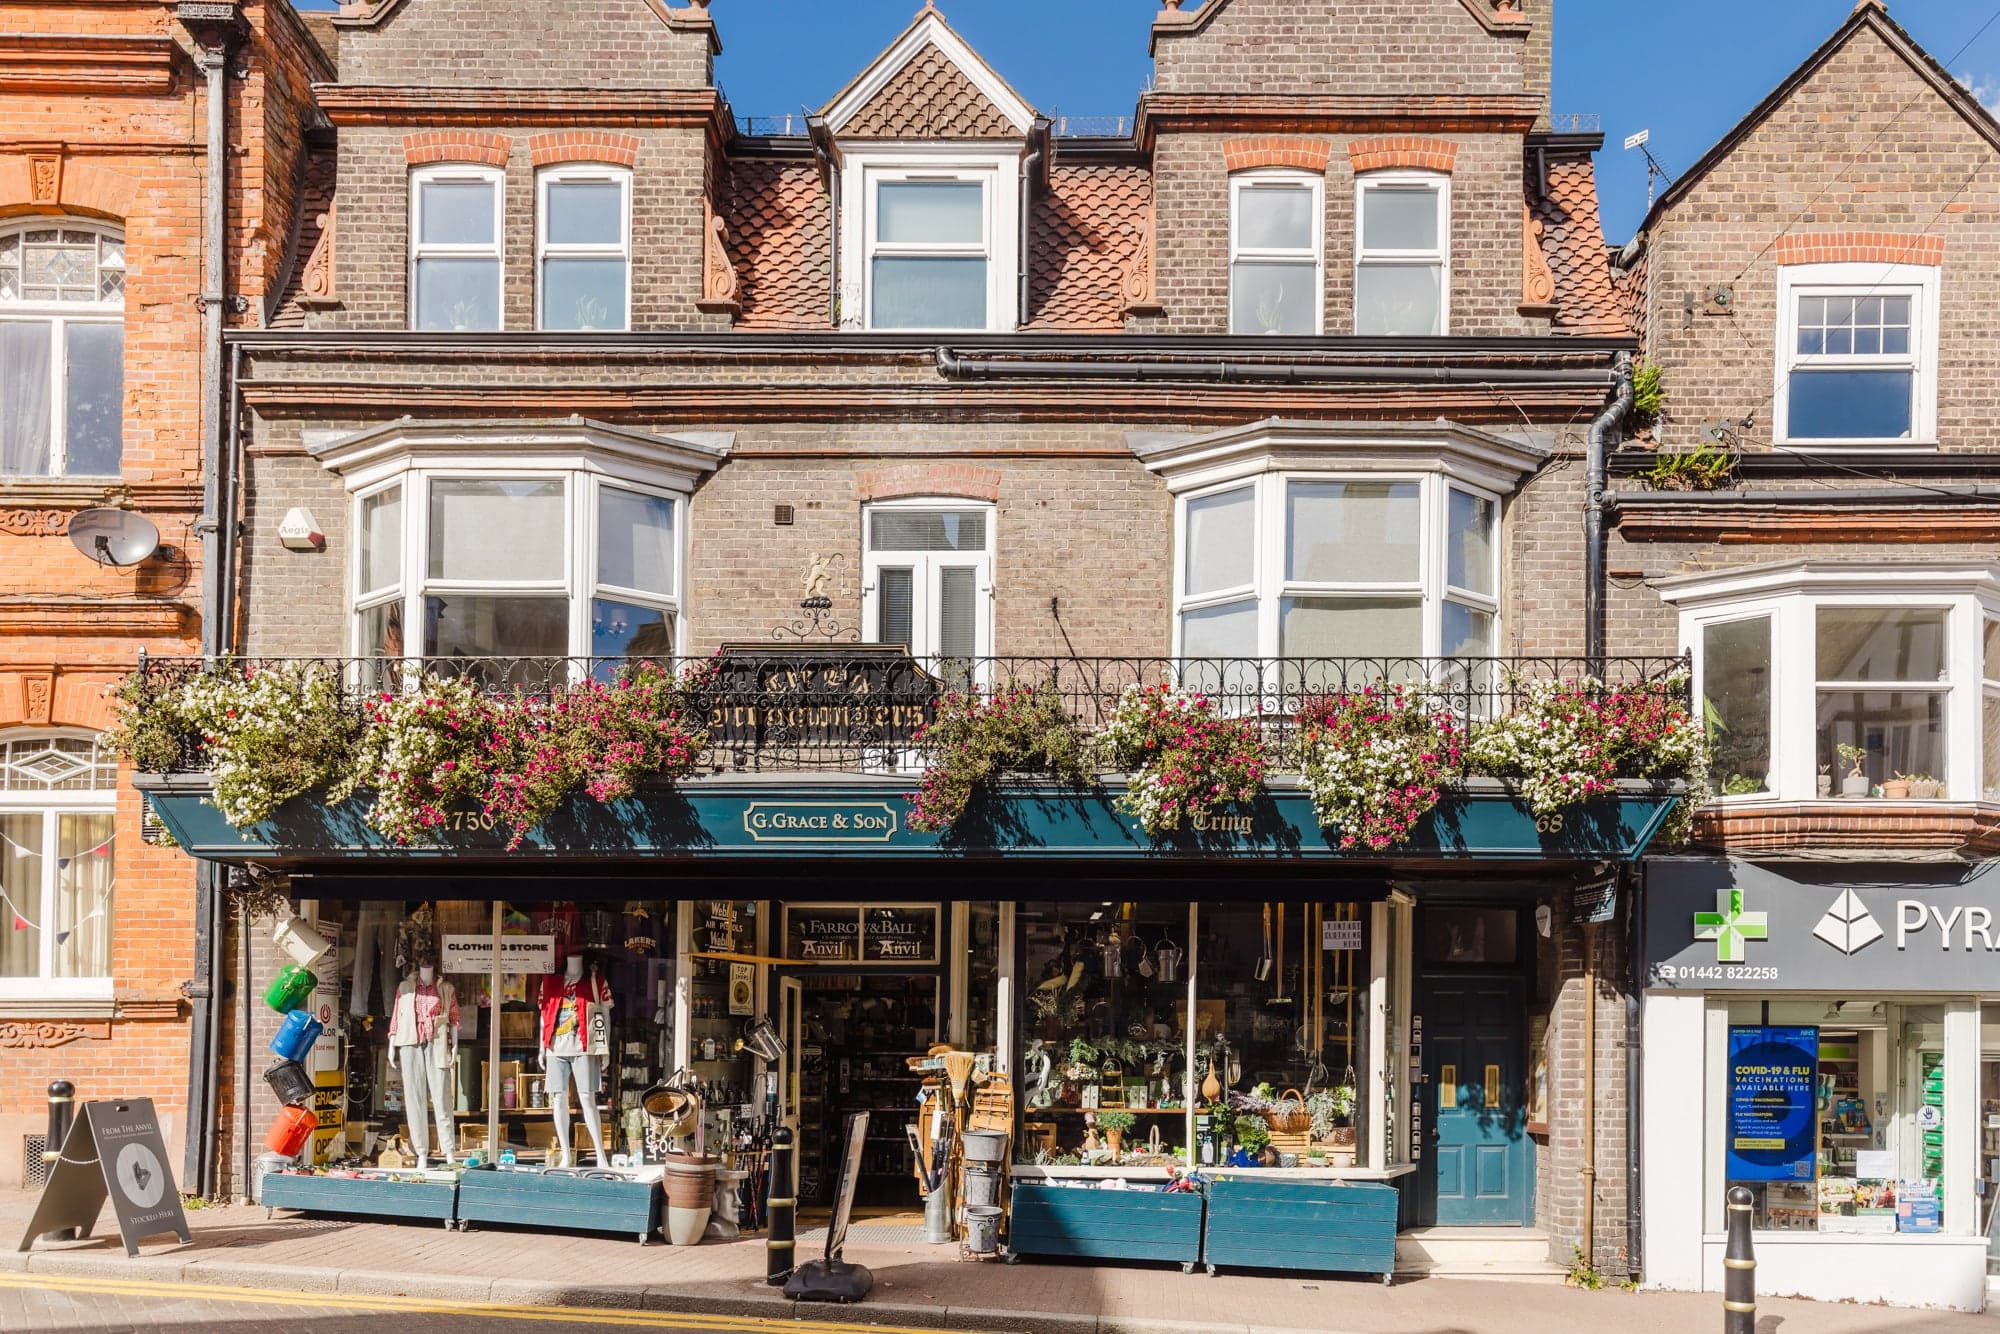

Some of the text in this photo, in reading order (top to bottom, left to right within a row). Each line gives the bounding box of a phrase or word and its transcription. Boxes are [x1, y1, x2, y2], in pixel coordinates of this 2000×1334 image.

[832, 813, 848, 829] &
[854, 813, 887, 829] SON
[1193, 807, 1253, 835] Tring
[1536, 814, 1564, 833] 68
[1897, 900, 2000, 949] PYR
[447, 943, 549, 951] CLOTHIG STORE
[624, 936, 657, 948] LAKERS
[801, 940, 843, 955] Anvil
[879, 940, 921, 955] Anvil
[1679, 966, 1779, 979] 01442 822258
[593, 1012, 606, 1045] LOFT
[1735, 1066, 1810, 1075] COVID-19 & FLU
[318, 1111, 336, 1124] HIRE
[102, 1127, 120, 1136] FROM
